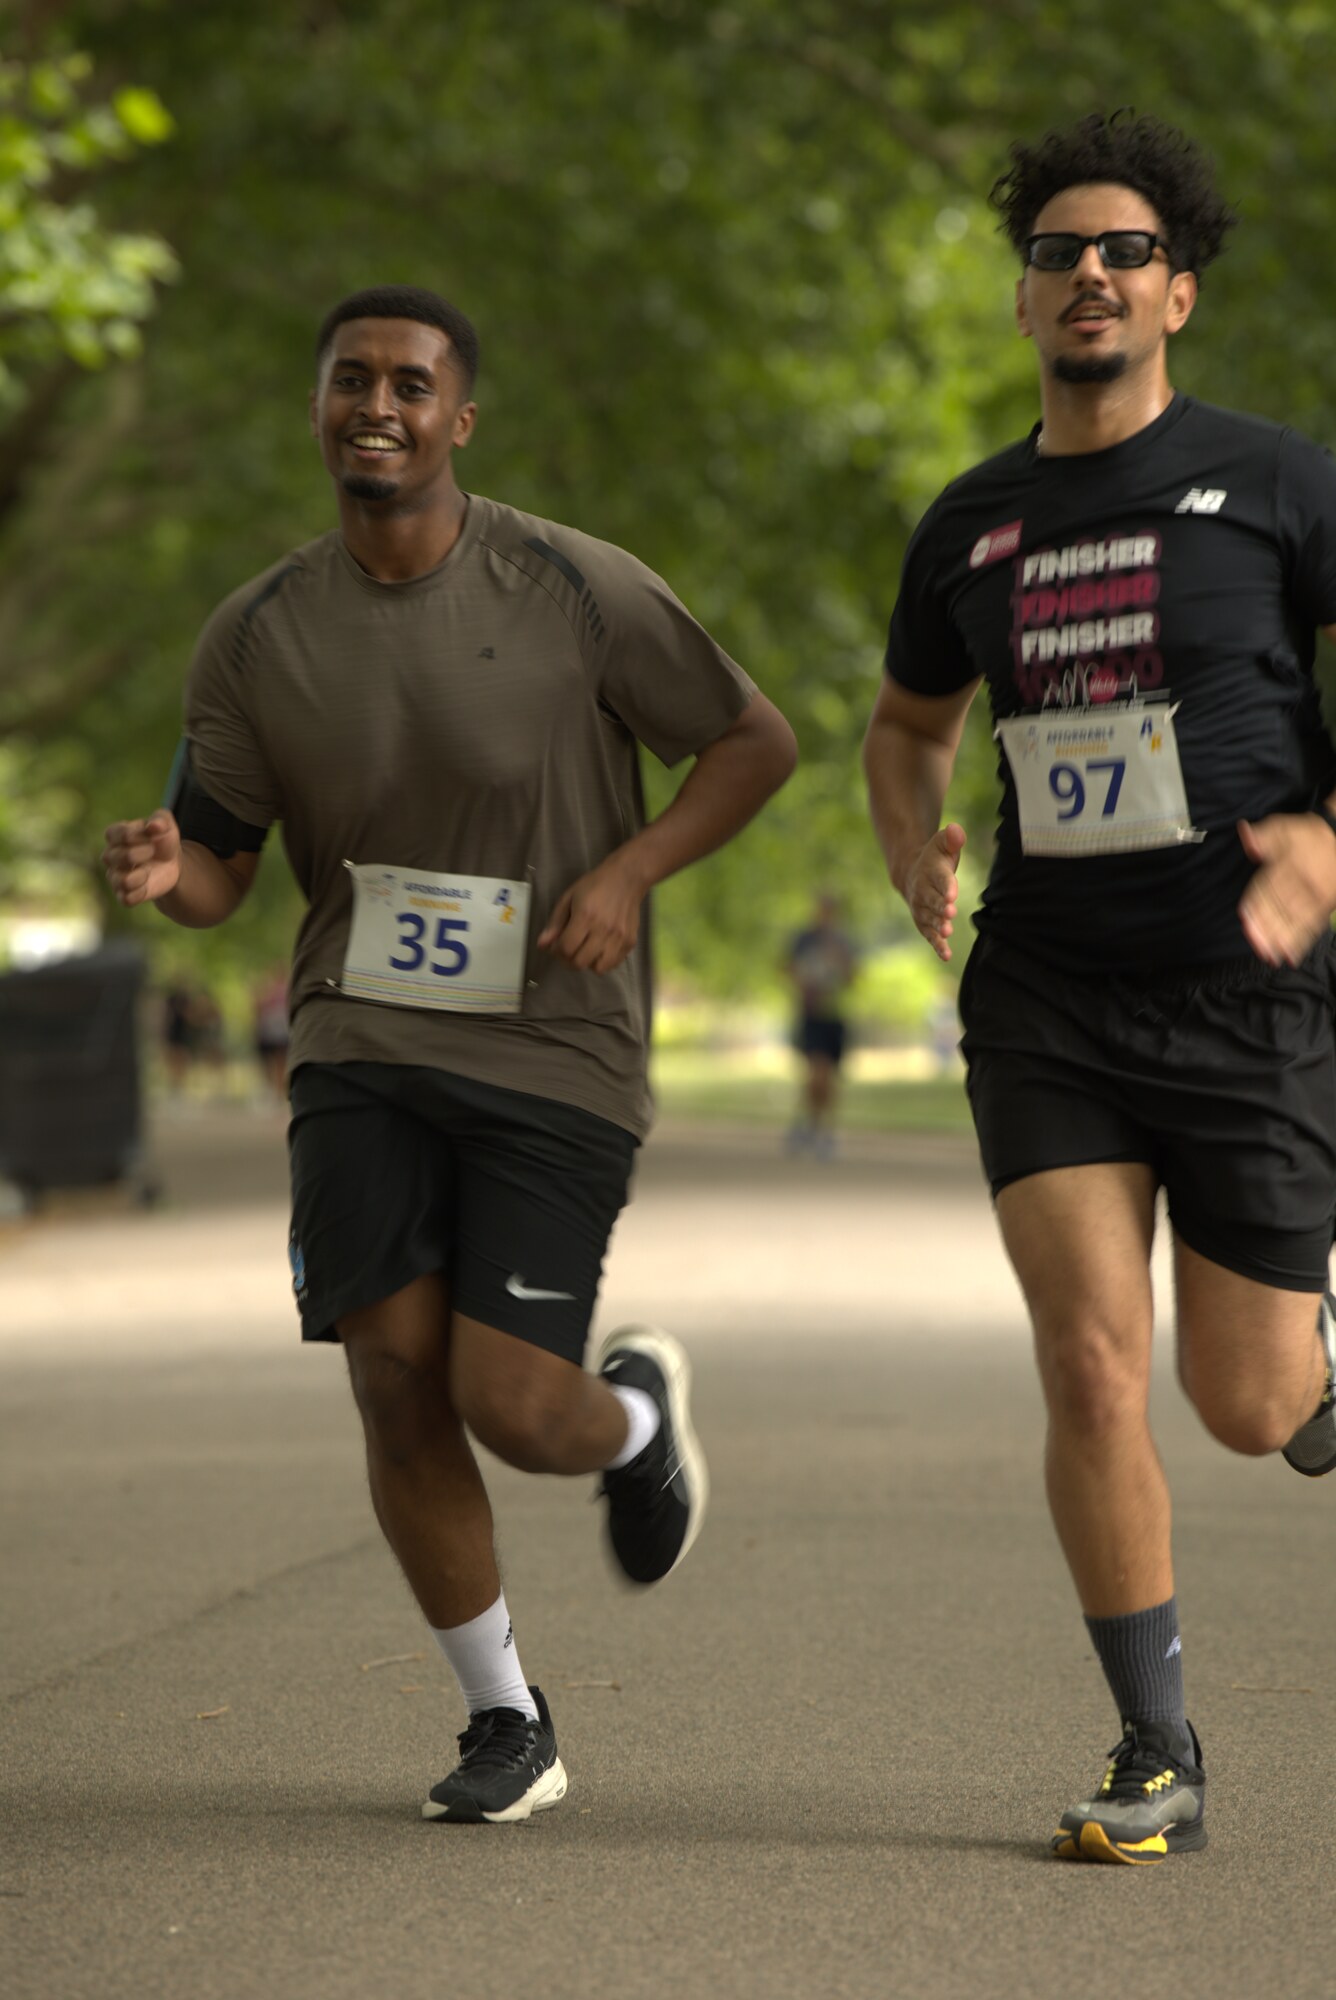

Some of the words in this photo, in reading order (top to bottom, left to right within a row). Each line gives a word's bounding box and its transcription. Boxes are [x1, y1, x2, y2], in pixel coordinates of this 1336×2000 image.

[1022, 535, 1157, 586] FINISHER
[1020, 611, 1155, 664] FINISHER
[1048, 755, 1126, 824] 97
[388, 911, 471, 977] 35
